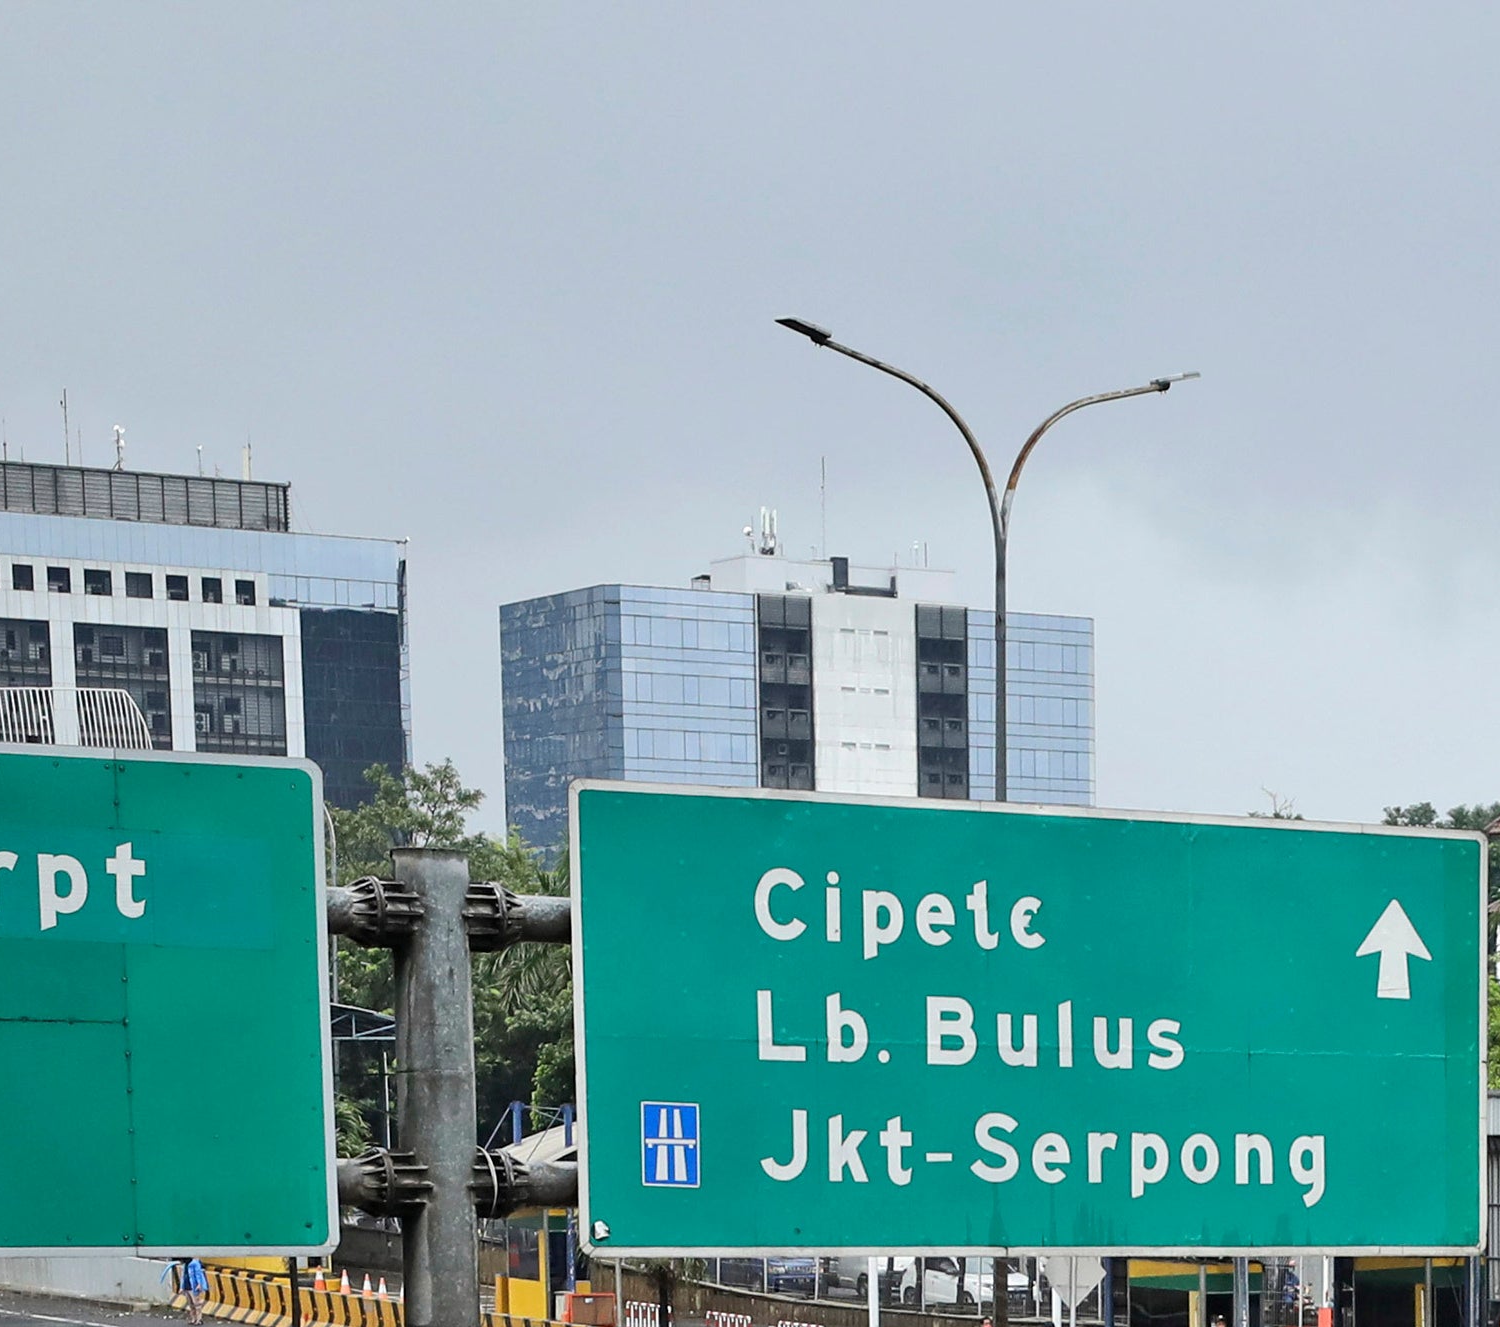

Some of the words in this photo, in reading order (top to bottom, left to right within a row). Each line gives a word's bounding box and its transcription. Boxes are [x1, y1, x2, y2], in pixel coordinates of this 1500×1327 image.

[756, 989, 891, 1065] Lb.
[925, 995, 1186, 1071] Bulus
[759, 1108, 1326, 1209] Jkt-Serpong
